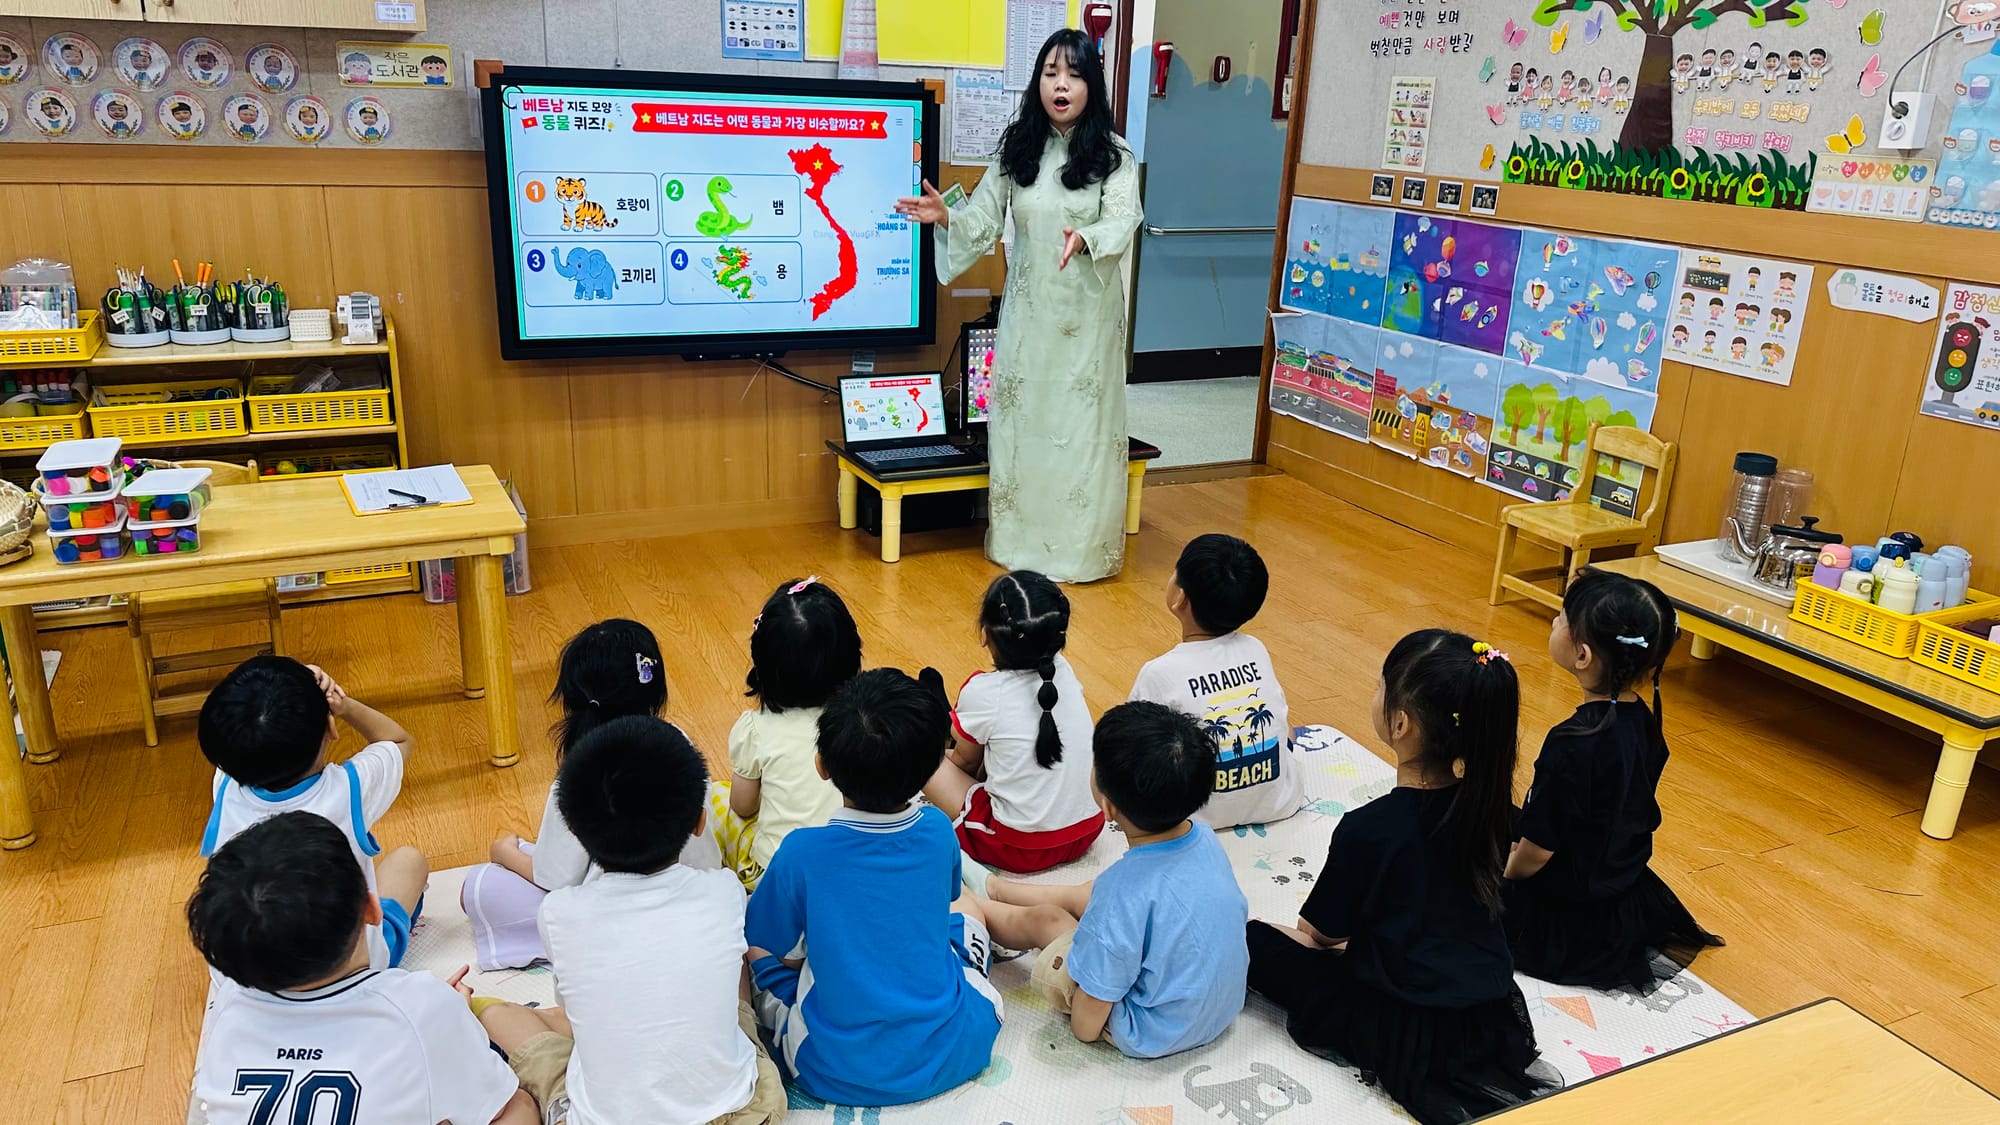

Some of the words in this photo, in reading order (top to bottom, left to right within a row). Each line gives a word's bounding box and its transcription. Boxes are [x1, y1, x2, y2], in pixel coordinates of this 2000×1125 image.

[1437, 10, 1460, 24] 보며
[1370, 37, 1412, 57] 벅찰만큼
[384, 51, 409, 63] 작은
[376, 64, 419, 78] 도서관
[522, 98, 564, 112] 베트남
[567, 101, 589, 112] 지도
[591, 102, 612, 114] 모양
[1694, 98, 1734, 115] 우리반에
[1740, 101, 1760, 118] 모두
[1769, 102, 1810, 121] 모였네?
[542, 115, 570, 131] 동물
[574, 116, 605, 130] 퀴즈!
[655, 112, 689, 126] 베트남
[692, 113, 724, 127] 지도는
[727, 114, 748, 128] 어떤
[751, 114, 782, 129] 동물과
[785, 116, 806, 129] 가장
[809, 117, 865, 131] 비슷할까요?
[1686, 127, 1707, 144] 완전
[1715, 131, 1755, 148] 럭키비키
[531, 184, 540, 199] 1
[670, 183, 680, 198] 2
[616, 198, 650, 211] 호랑이
[772, 199, 784, 216] 뱀
[900, 222, 908, 231] SA
[532, 254, 541, 268] 3
[674, 252, 685, 266] 4
[621, 267, 656, 284] 코끼리
[776, 263, 787, 280] 용
[1888, 289, 1930, 309] 정리해요
[1188, 661, 1262, 698] PARADISE
[1215, 758, 1272, 790] BEACH
[277, 1048, 324, 1060] PARIS
[231, 1069, 362, 1125] 70
